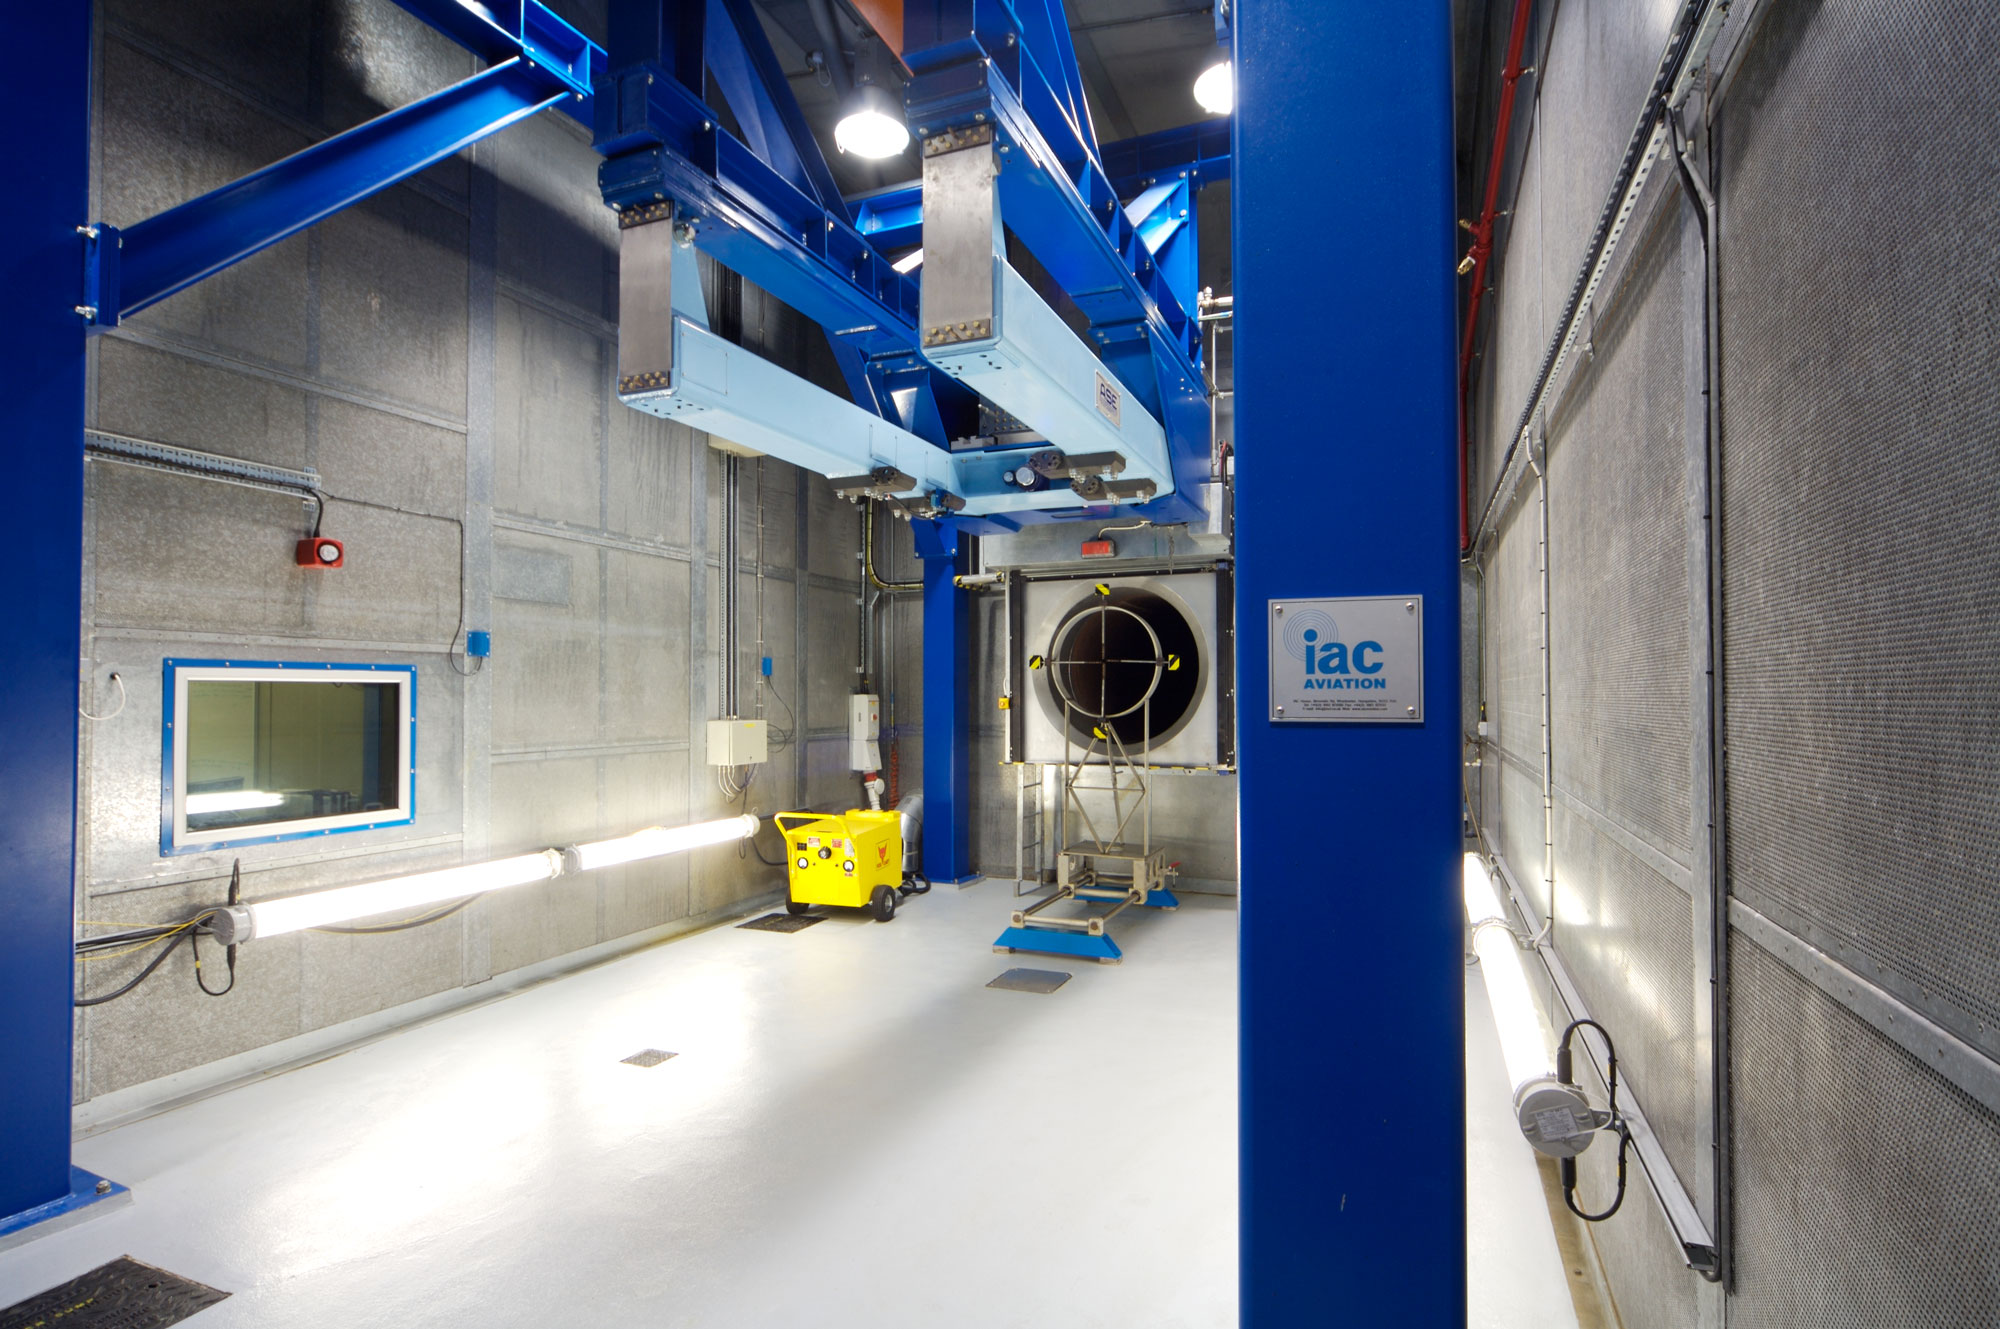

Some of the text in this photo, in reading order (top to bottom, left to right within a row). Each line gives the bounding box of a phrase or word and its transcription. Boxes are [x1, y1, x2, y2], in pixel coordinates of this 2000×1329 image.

[1100, 383, 1117, 410] ASE
[1303, 628, 1384, 675] iac
[1303, 678, 1386, 690] AVIATION
